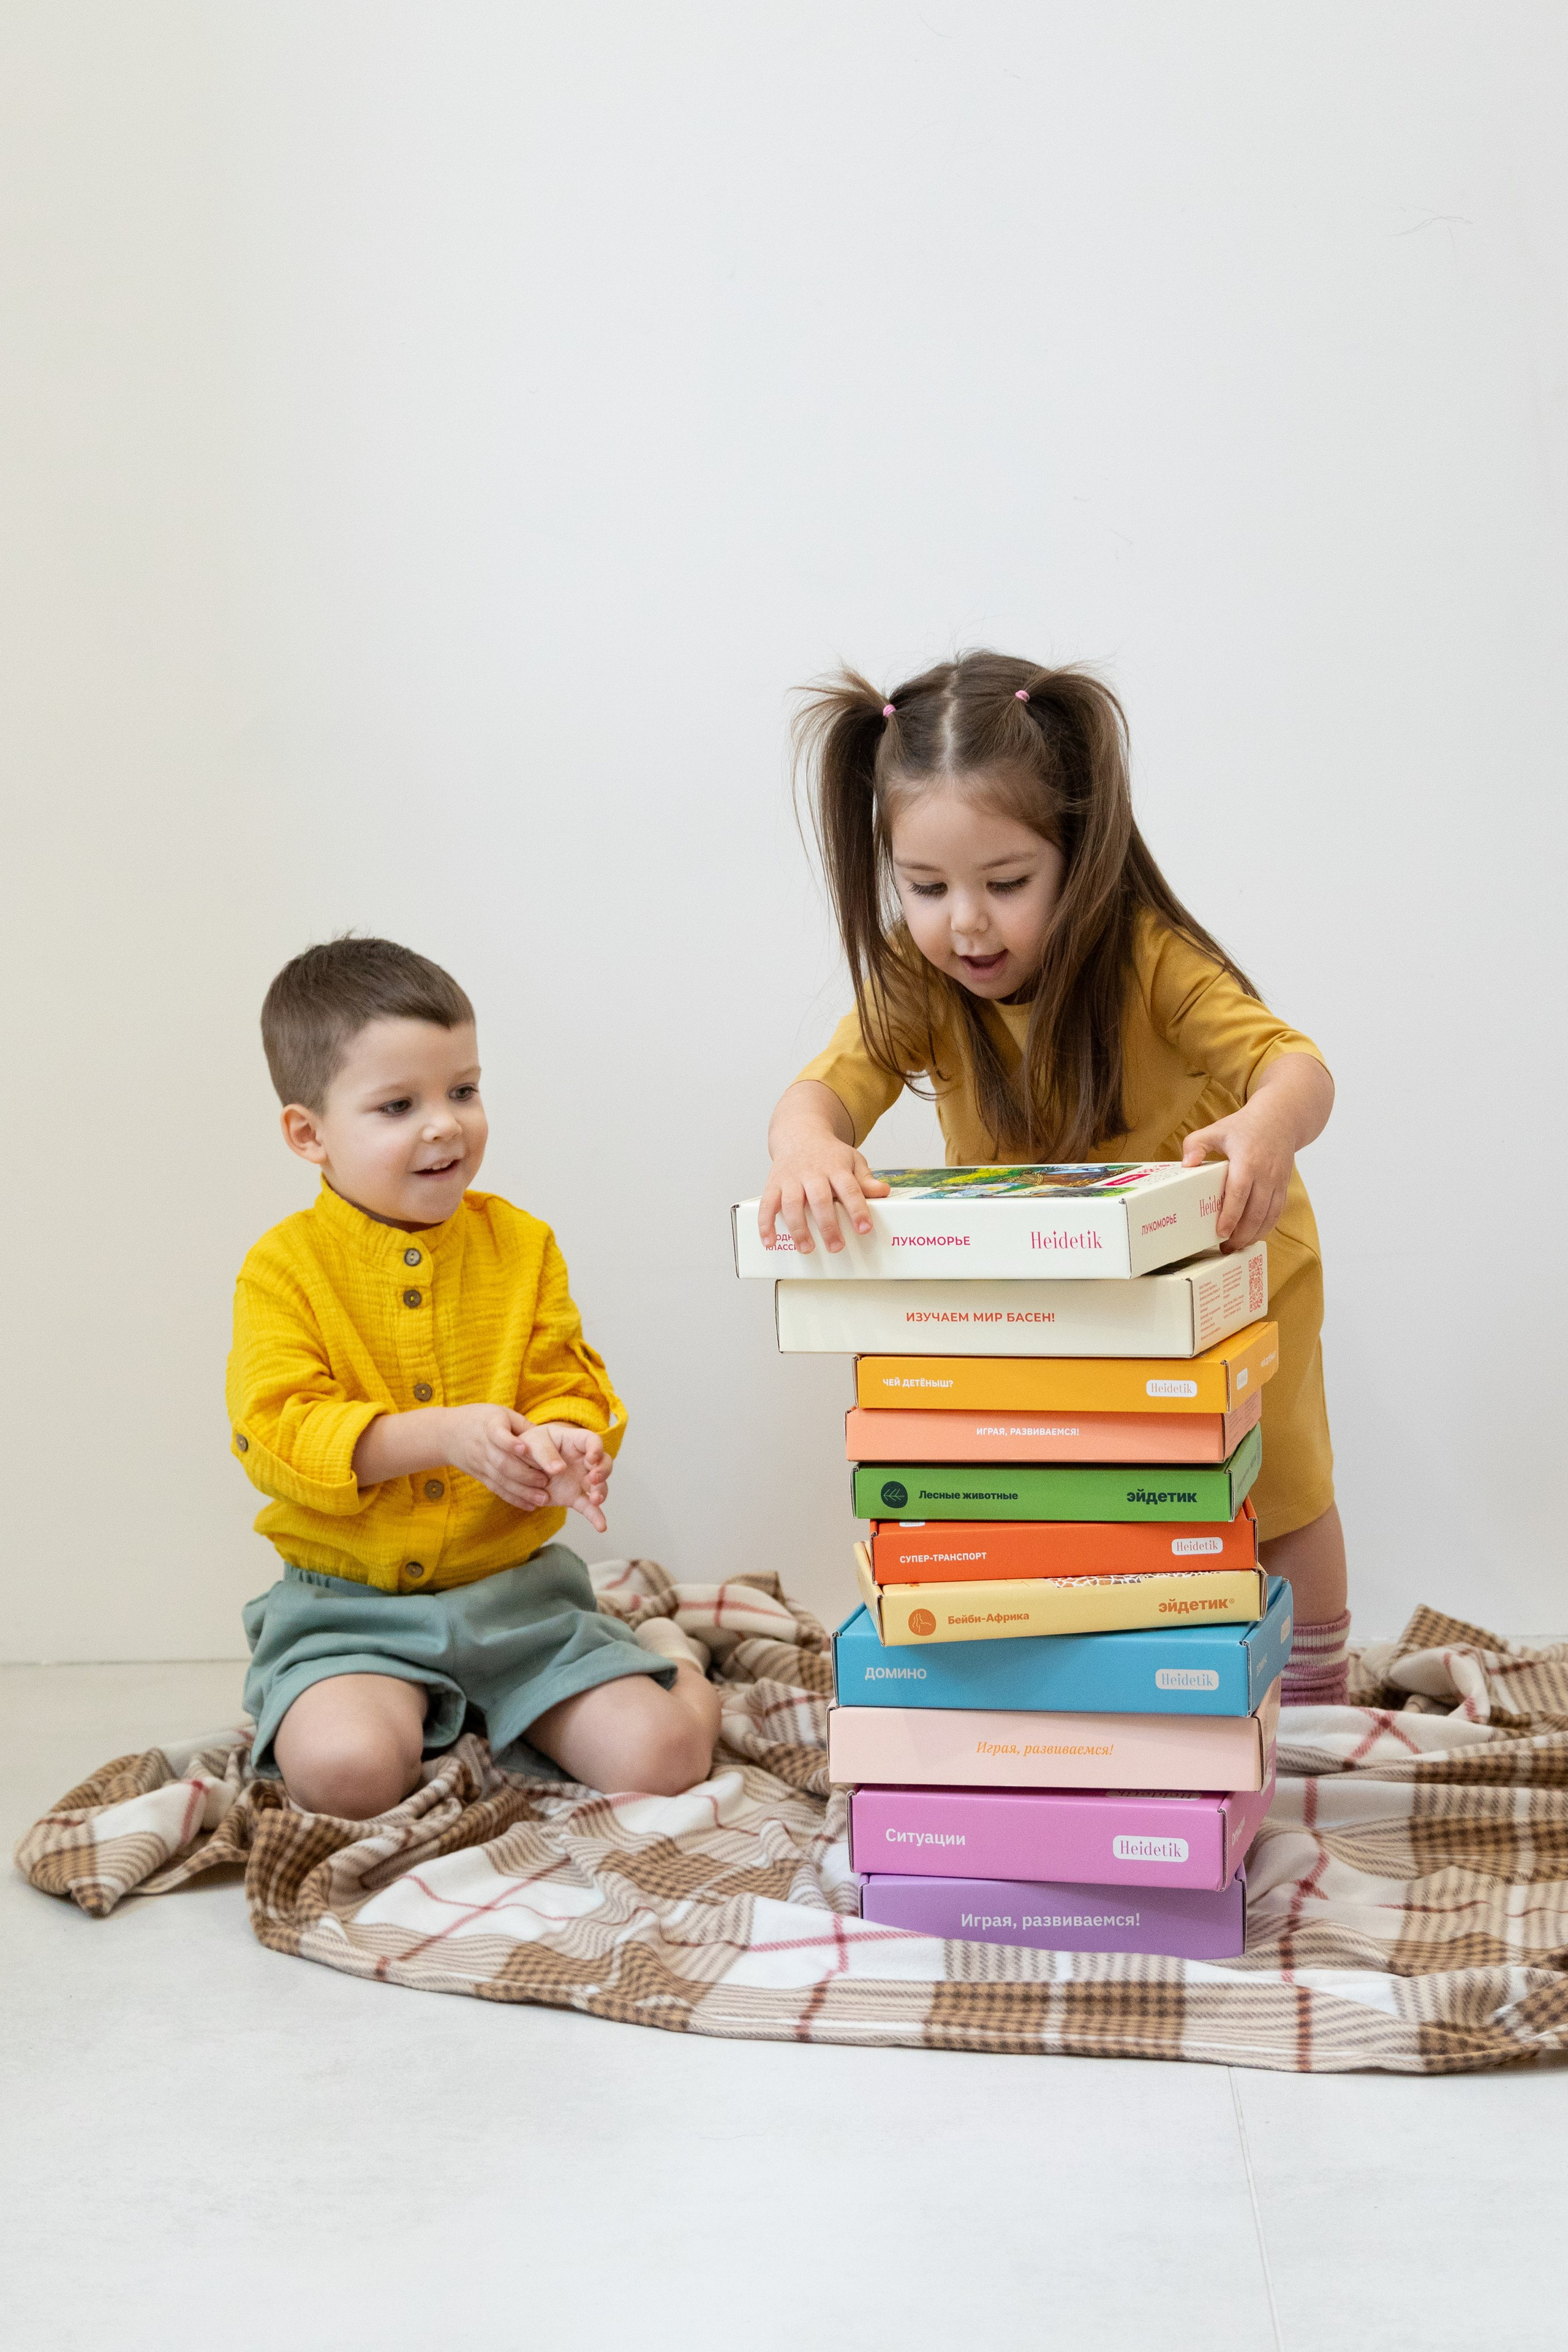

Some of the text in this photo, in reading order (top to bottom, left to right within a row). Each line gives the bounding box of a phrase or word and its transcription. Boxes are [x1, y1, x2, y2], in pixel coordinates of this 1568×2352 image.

[1142, 1213, 1178, 1235] ЛУКОМОРЬЕ
[891, 1236, 971, 1246] ЛУКОМОРЬЕ
[1031, 1230, 1102, 1249] Heidetik
[906, 1312, 1055, 1322] ИЗУЧАЕМ МИР БАСЕН!
[882, 1376, 954, 1388] ЧЕЙ ДЕТЁНЫШ?
[1150, 1382, 1193, 1395] Heidetik
[976, 1427, 1080, 1437] ИГРАЯ, РАЗВИВАЕМСЯ!
[919, 1490, 961, 1499] Лесные
[1126, 1488, 1197, 1505] эйдетик
[1175, 1539, 1219, 1552] Heidetik
[899, 1551, 987, 1564] СУПЕР-ТРАНСПОРТ
[948, 1612, 1030, 1625] Бейби-Африка
[864, 1667, 927, 1681] ДОМИНО
[1161, 1673, 1214, 1687] Heidetik
[976, 1741, 1114, 1757] Играя, развиваемся!
[885, 1828, 966, 1847] Ситуации
[1119, 1839, 1182, 1858] Heidetik
[961, 1912, 1140, 1931] Играя, развиваемся!
